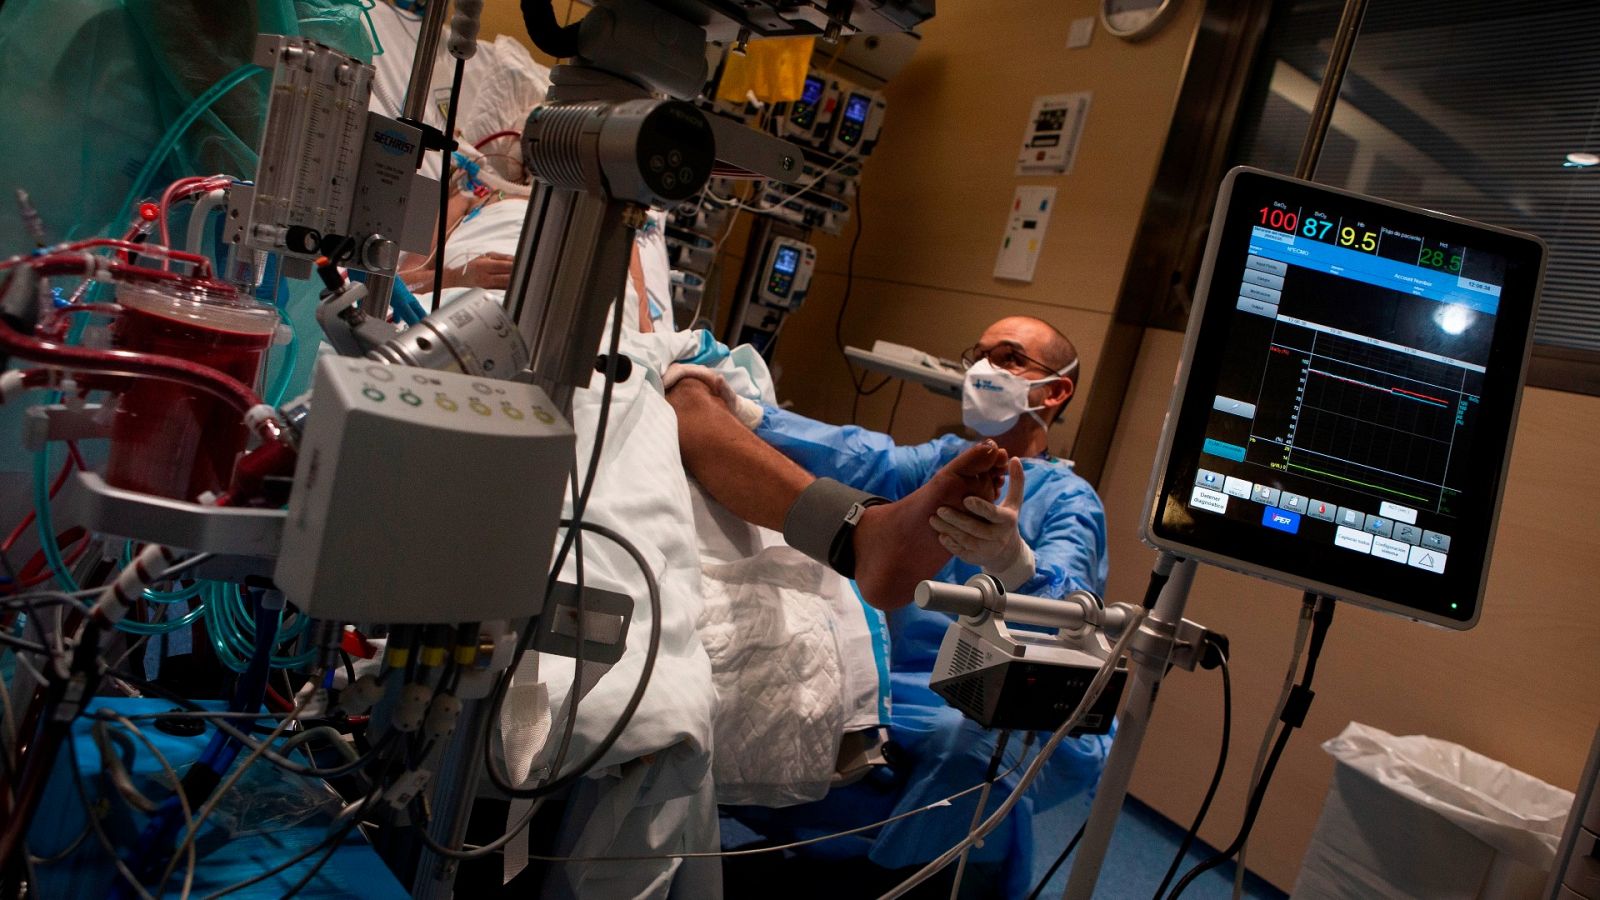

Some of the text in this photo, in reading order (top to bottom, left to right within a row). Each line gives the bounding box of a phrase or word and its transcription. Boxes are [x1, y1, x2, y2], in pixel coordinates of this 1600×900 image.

[372, 131, 416, 154] SECHRIST
[1259, 206, 1297, 231] 100
[1303, 217, 1333, 240] 87
[1340, 226, 1377, 251] 9.5
[1420, 248, 1461, 271] 28.5
[1394, 272, 1432, 286] Account Number
[1200, 492, 1220, 501] Detener
[1271, 512, 1291, 525] VIPER
